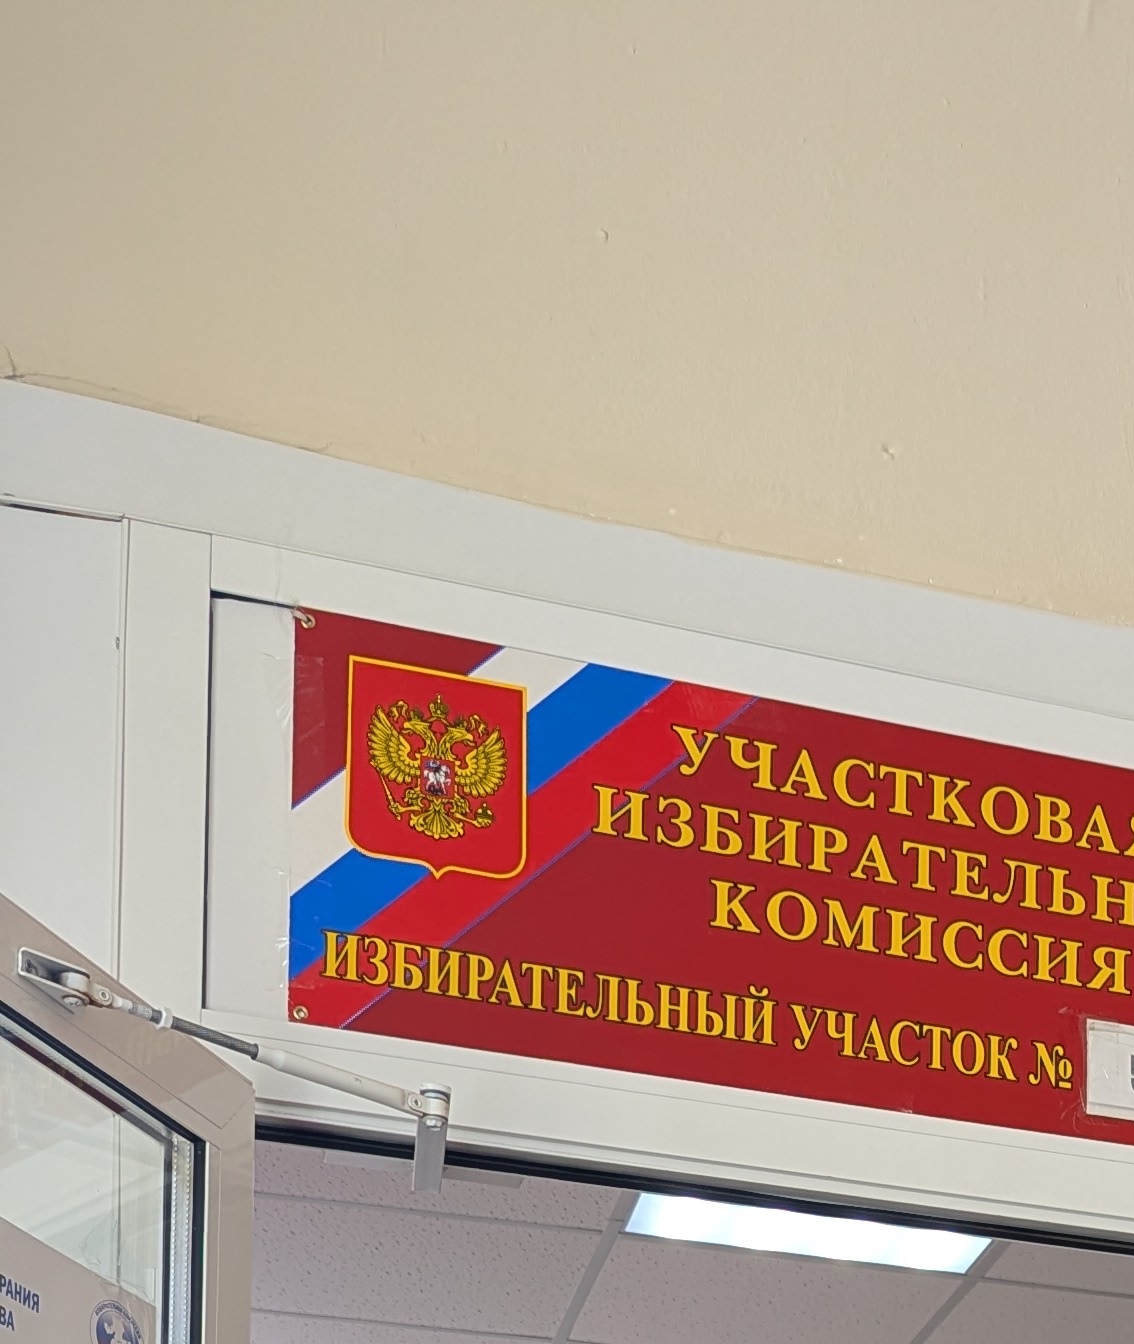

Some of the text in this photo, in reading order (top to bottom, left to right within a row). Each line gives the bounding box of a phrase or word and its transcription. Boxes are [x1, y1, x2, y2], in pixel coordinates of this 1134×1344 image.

[710, 878, 1132, 996] КОМИССИЯ
[322, 929, 777, 1046] ИЗБИРАТЕЛЬНЫЙ
[789, 1004, 1018, 1082] УЧАСТОК
[1027, 1041, 1074, 1090] №
